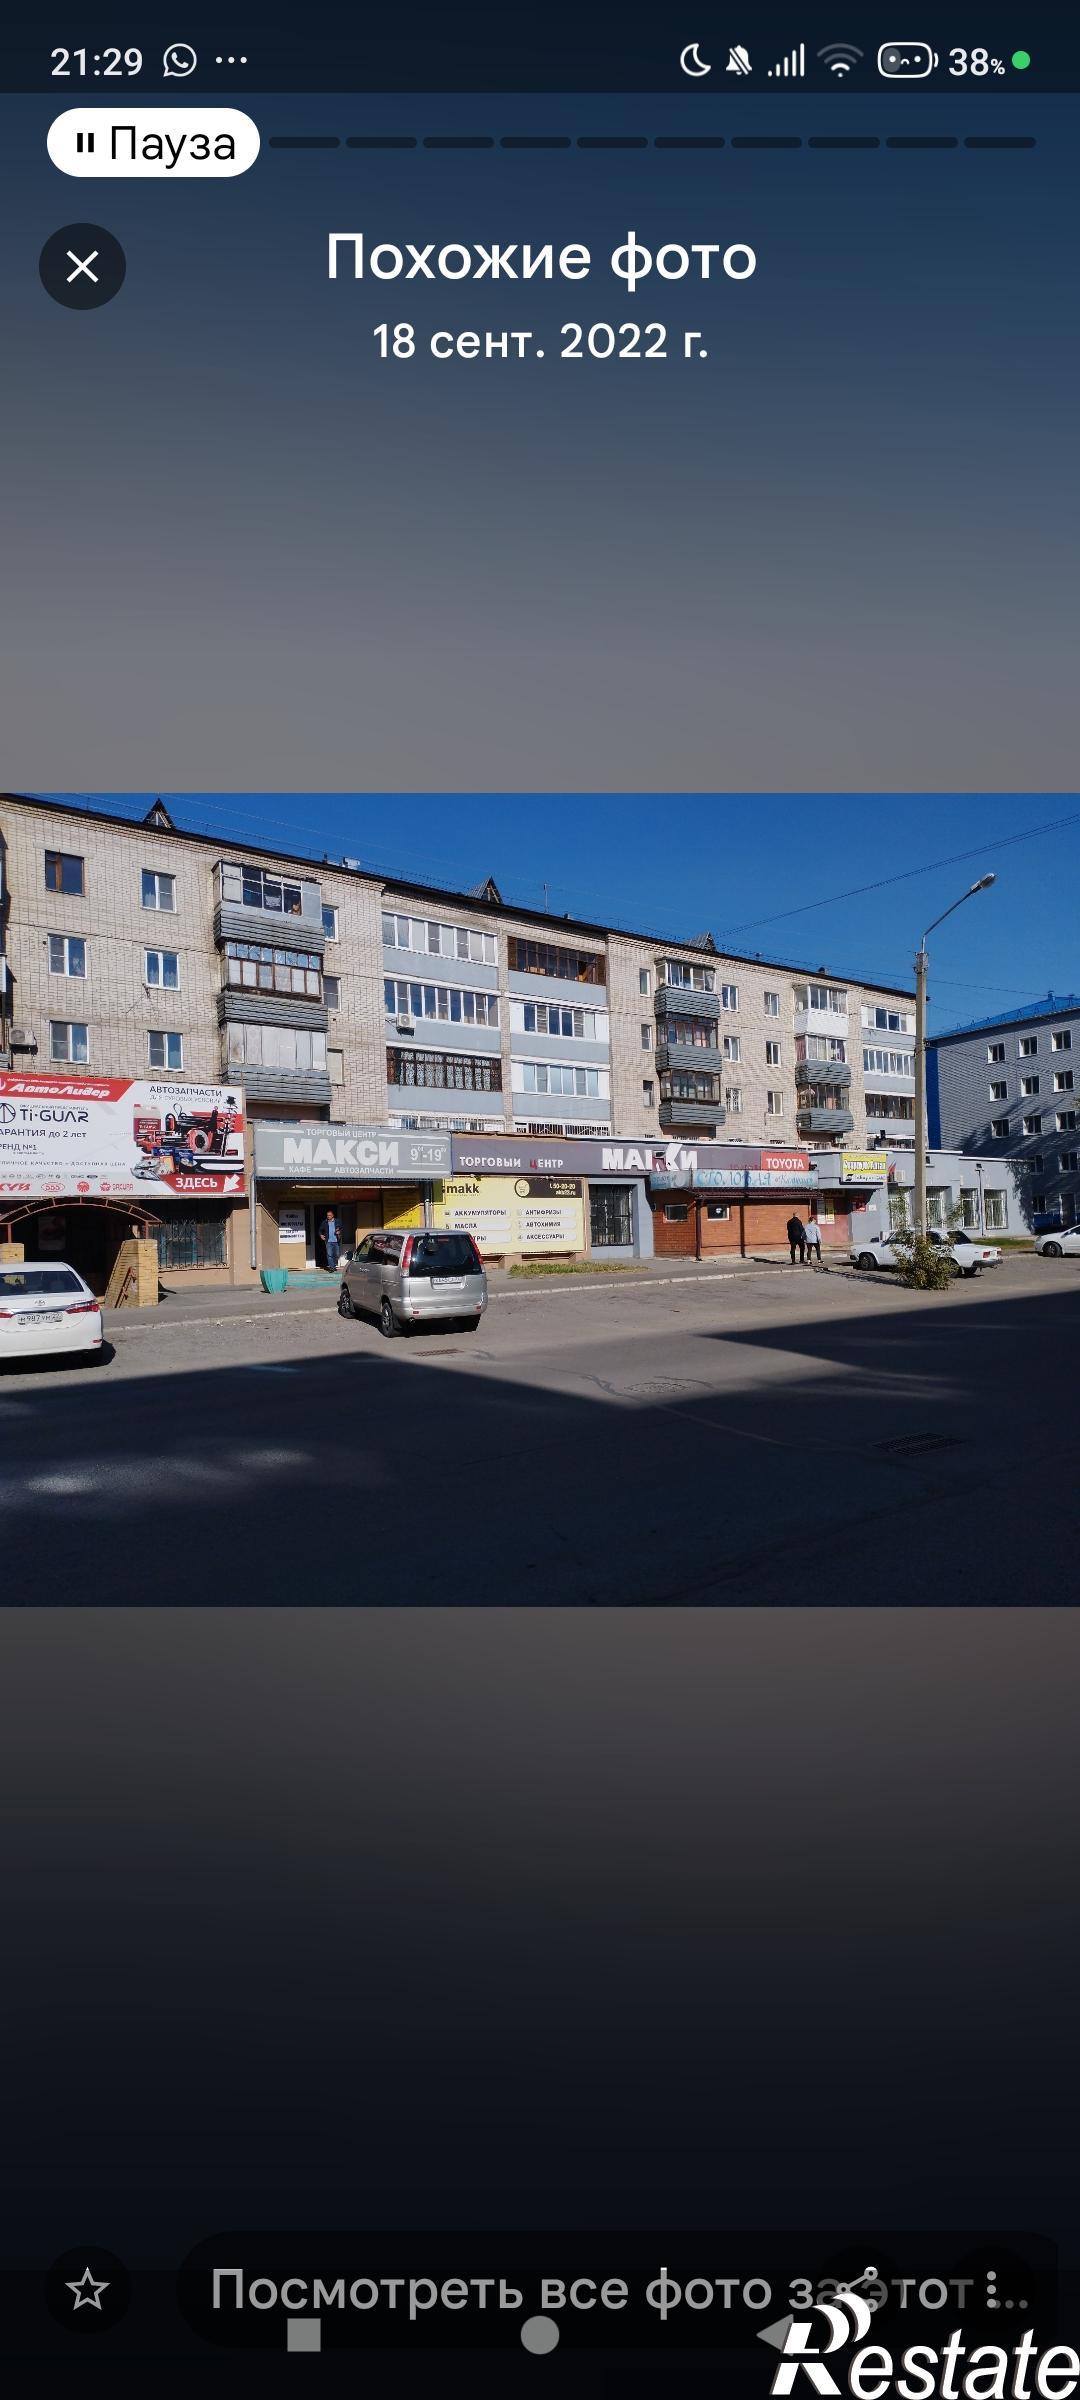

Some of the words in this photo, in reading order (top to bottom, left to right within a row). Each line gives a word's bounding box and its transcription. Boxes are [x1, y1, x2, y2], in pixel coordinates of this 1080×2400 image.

[149, 1085, 222, 1098] АВТОЗАПЧАСТИ
[306, 1128, 351, 1138] ТОРГОВЫЙ
[352, 1131, 377, 1139] ЦЕНТР
[283, 1138, 399, 1166] МАКСИ
[529, 1159, 564, 1170] ЦЕНТР
[765, 1158, 805, 1169] TOYOTA
[289, 1166, 312, 1174] КАФЕ
[334, 1167, 394, 1175] АВТОЗАПЧАСТИ
[175, 1177, 218, 1189] ЗДЕСЬ
[454, 1208, 507, 1217] АККУМУЛЯТОРЫ
